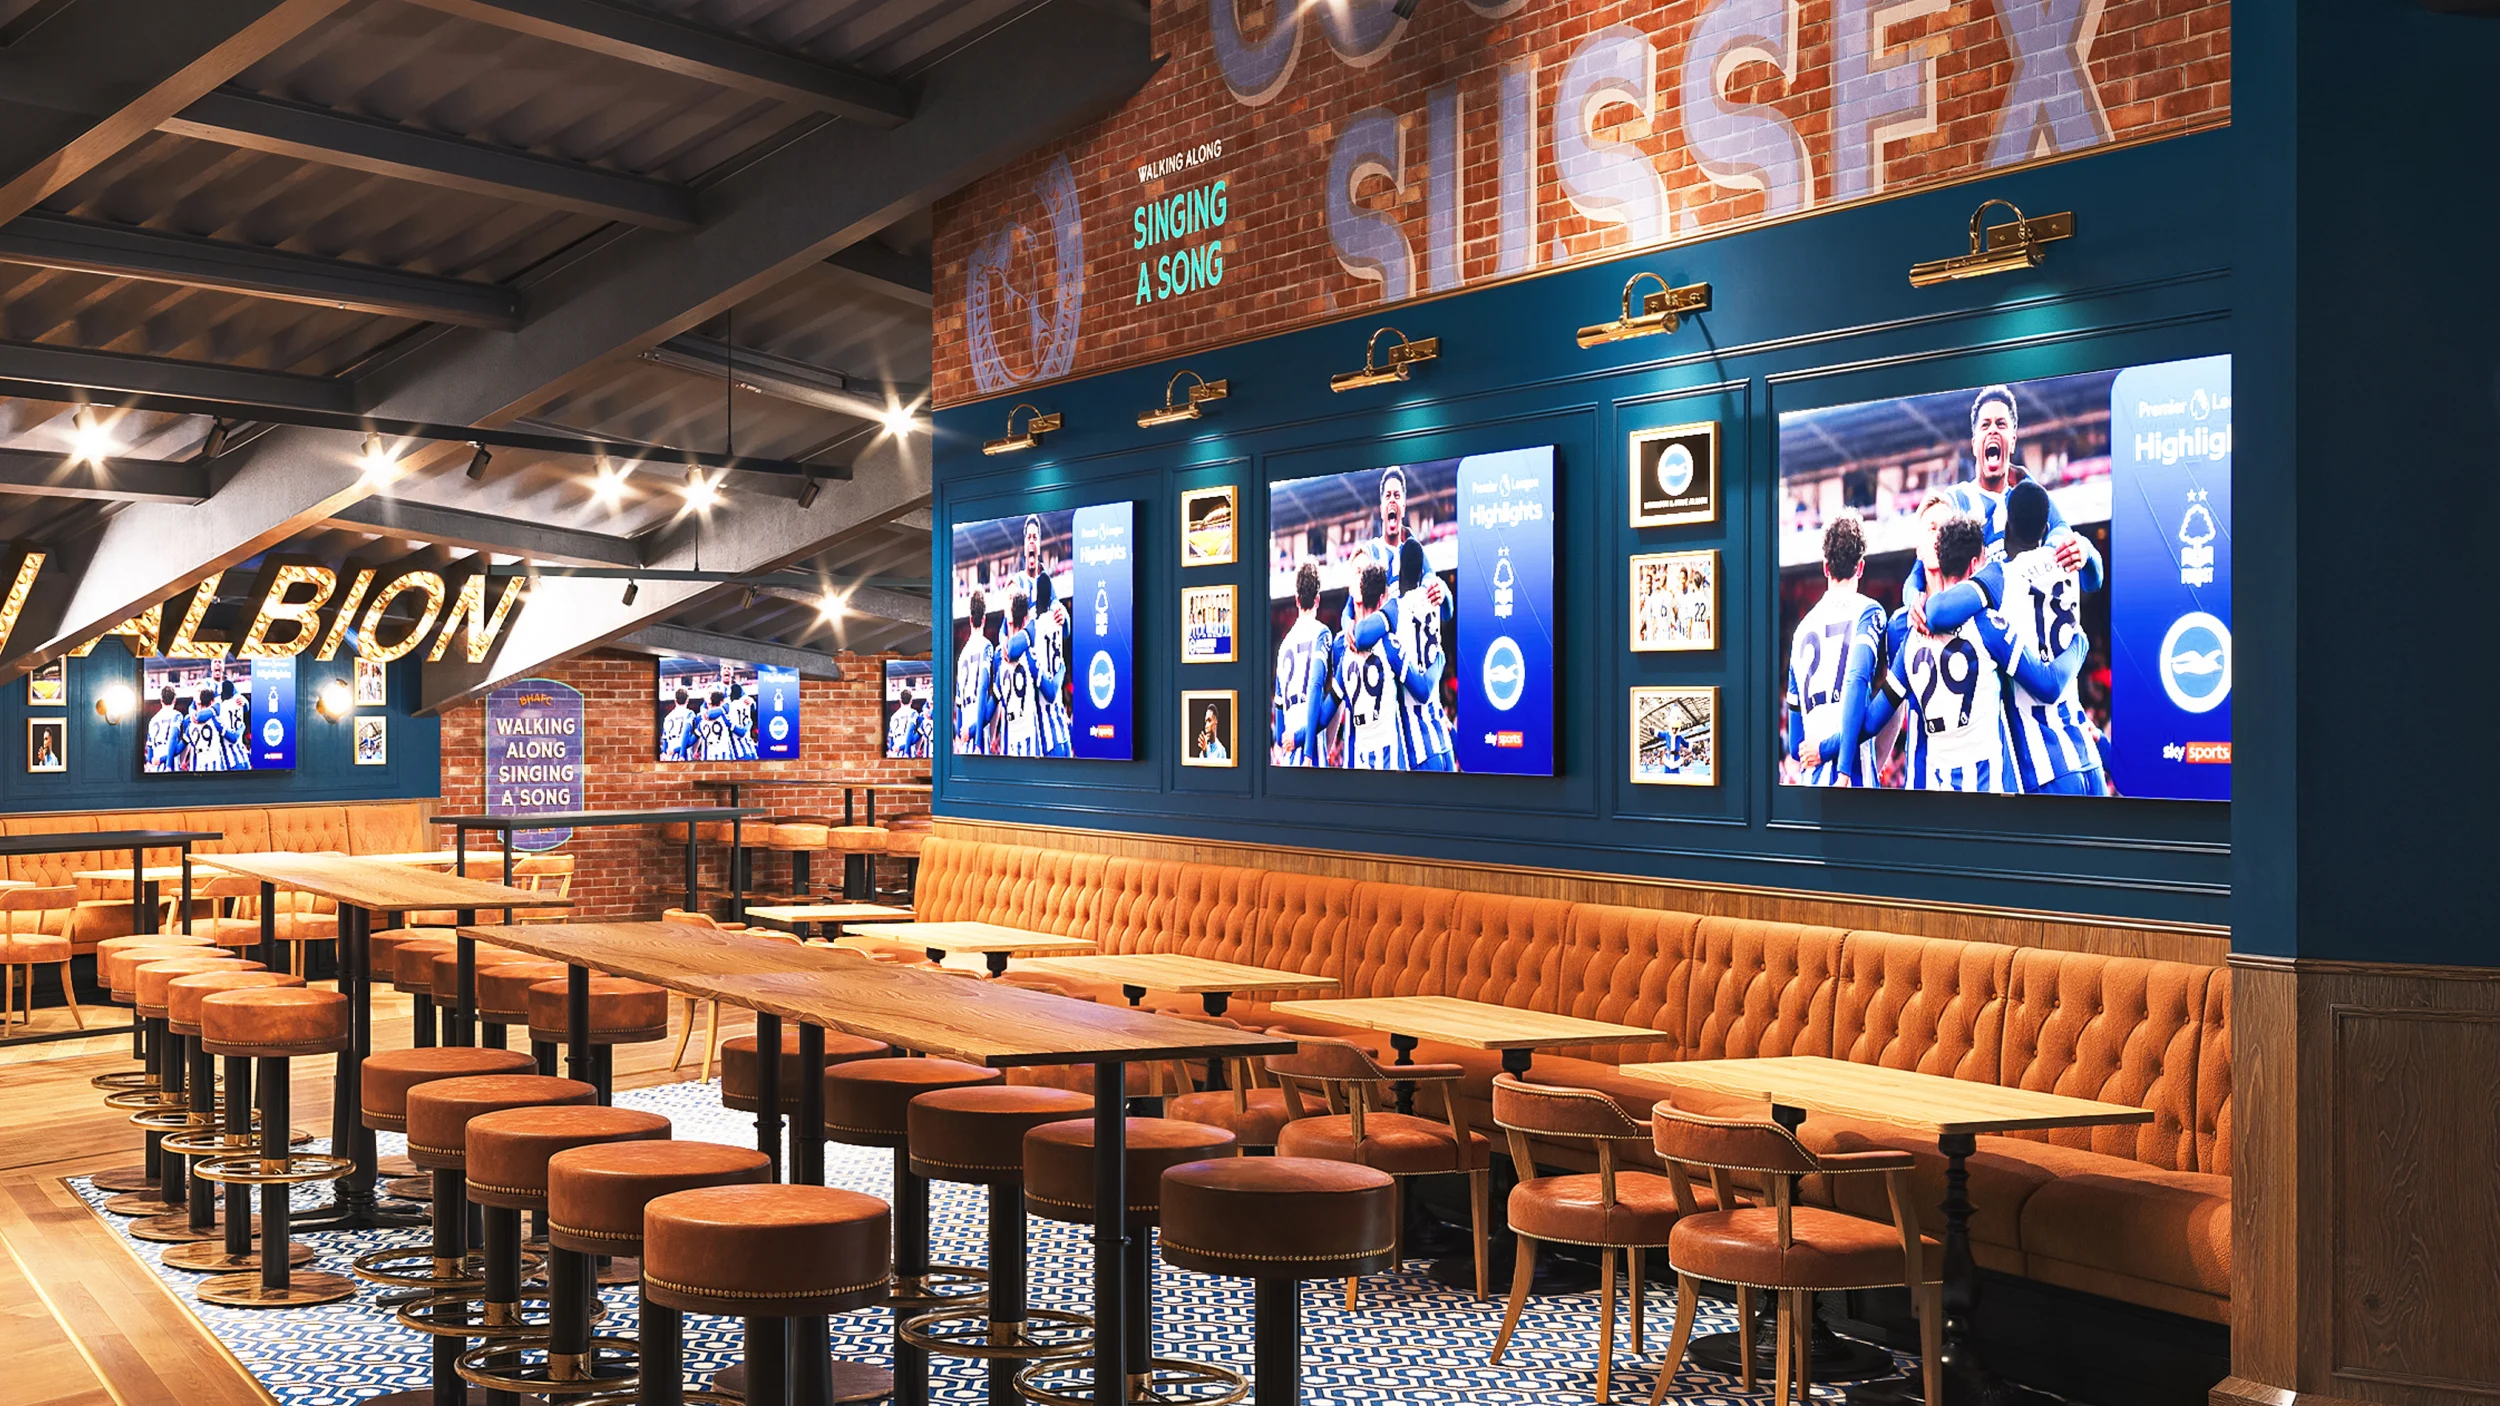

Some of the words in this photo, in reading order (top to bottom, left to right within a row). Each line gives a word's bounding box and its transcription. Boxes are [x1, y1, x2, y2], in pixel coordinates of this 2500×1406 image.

[1137, 152, 1184, 184] WALKING
[1185, 139, 1222, 168] ALONG
[1134, 180, 1227, 250] SINGING
[1136, 261, 1152, 306] A
[1158, 240, 1223, 300] SONG
[2137, 399, 2187, 419] Premier
[1469, 500, 1543, 529] Highlights
[2028, 578, 2078, 663] 18
[1411, 611, 1440, 673] 18
[962, 653, 981, 708] 27
[1282, 641, 1313, 712] 27
[1800, 620, 1854, 714] 27
[1912, 637, 1979, 734] 29
[519, 693, 553, 707] BHAFC
[1002, 662, 1027, 721] 29
[1347, 652, 1385, 726] 29
[152, 718, 172, 748] 27
[192, 724, 213, 753] 29
[495, 717, 575, 736] WALKING
[1498, 733, 1522, 747] sports
[505, 741, 566, 759] ALONG
[2162, 742, 2186, 762] sky
[2188, 743, 2231, 762] sports
[498, 765, 574, 783] SINGING
[501, 789, 513, 807] A
[520, 788, 570, 807] SONG
